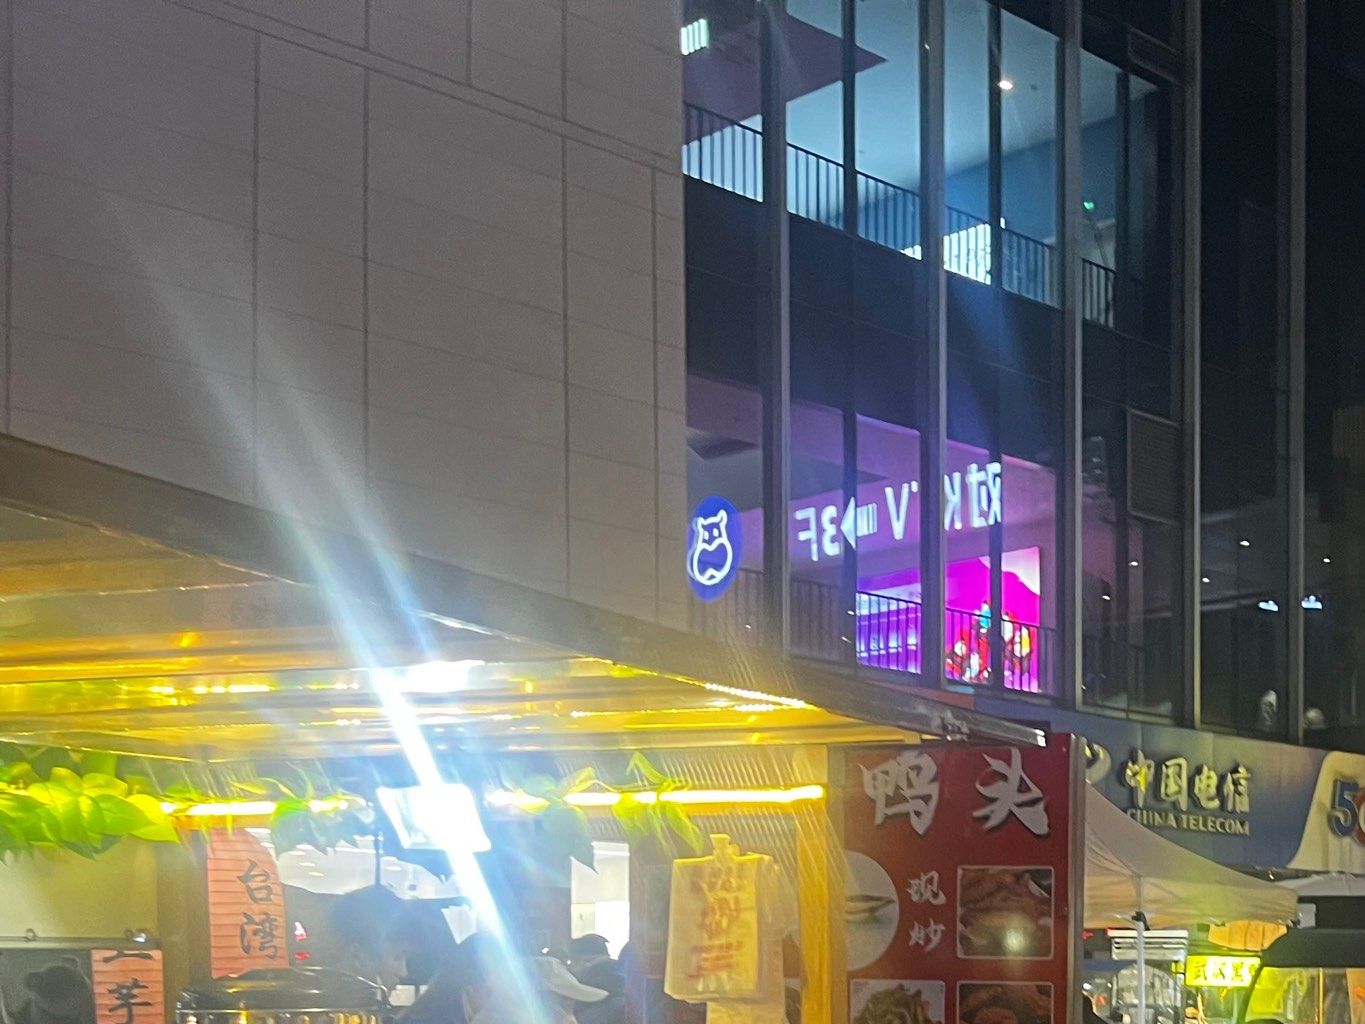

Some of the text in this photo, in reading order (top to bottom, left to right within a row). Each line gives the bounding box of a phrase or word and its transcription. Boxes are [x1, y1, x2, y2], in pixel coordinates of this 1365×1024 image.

[1121, 749, 1251, 814] 中国电信
[1179, 814, 1251, 836] TELECOM
